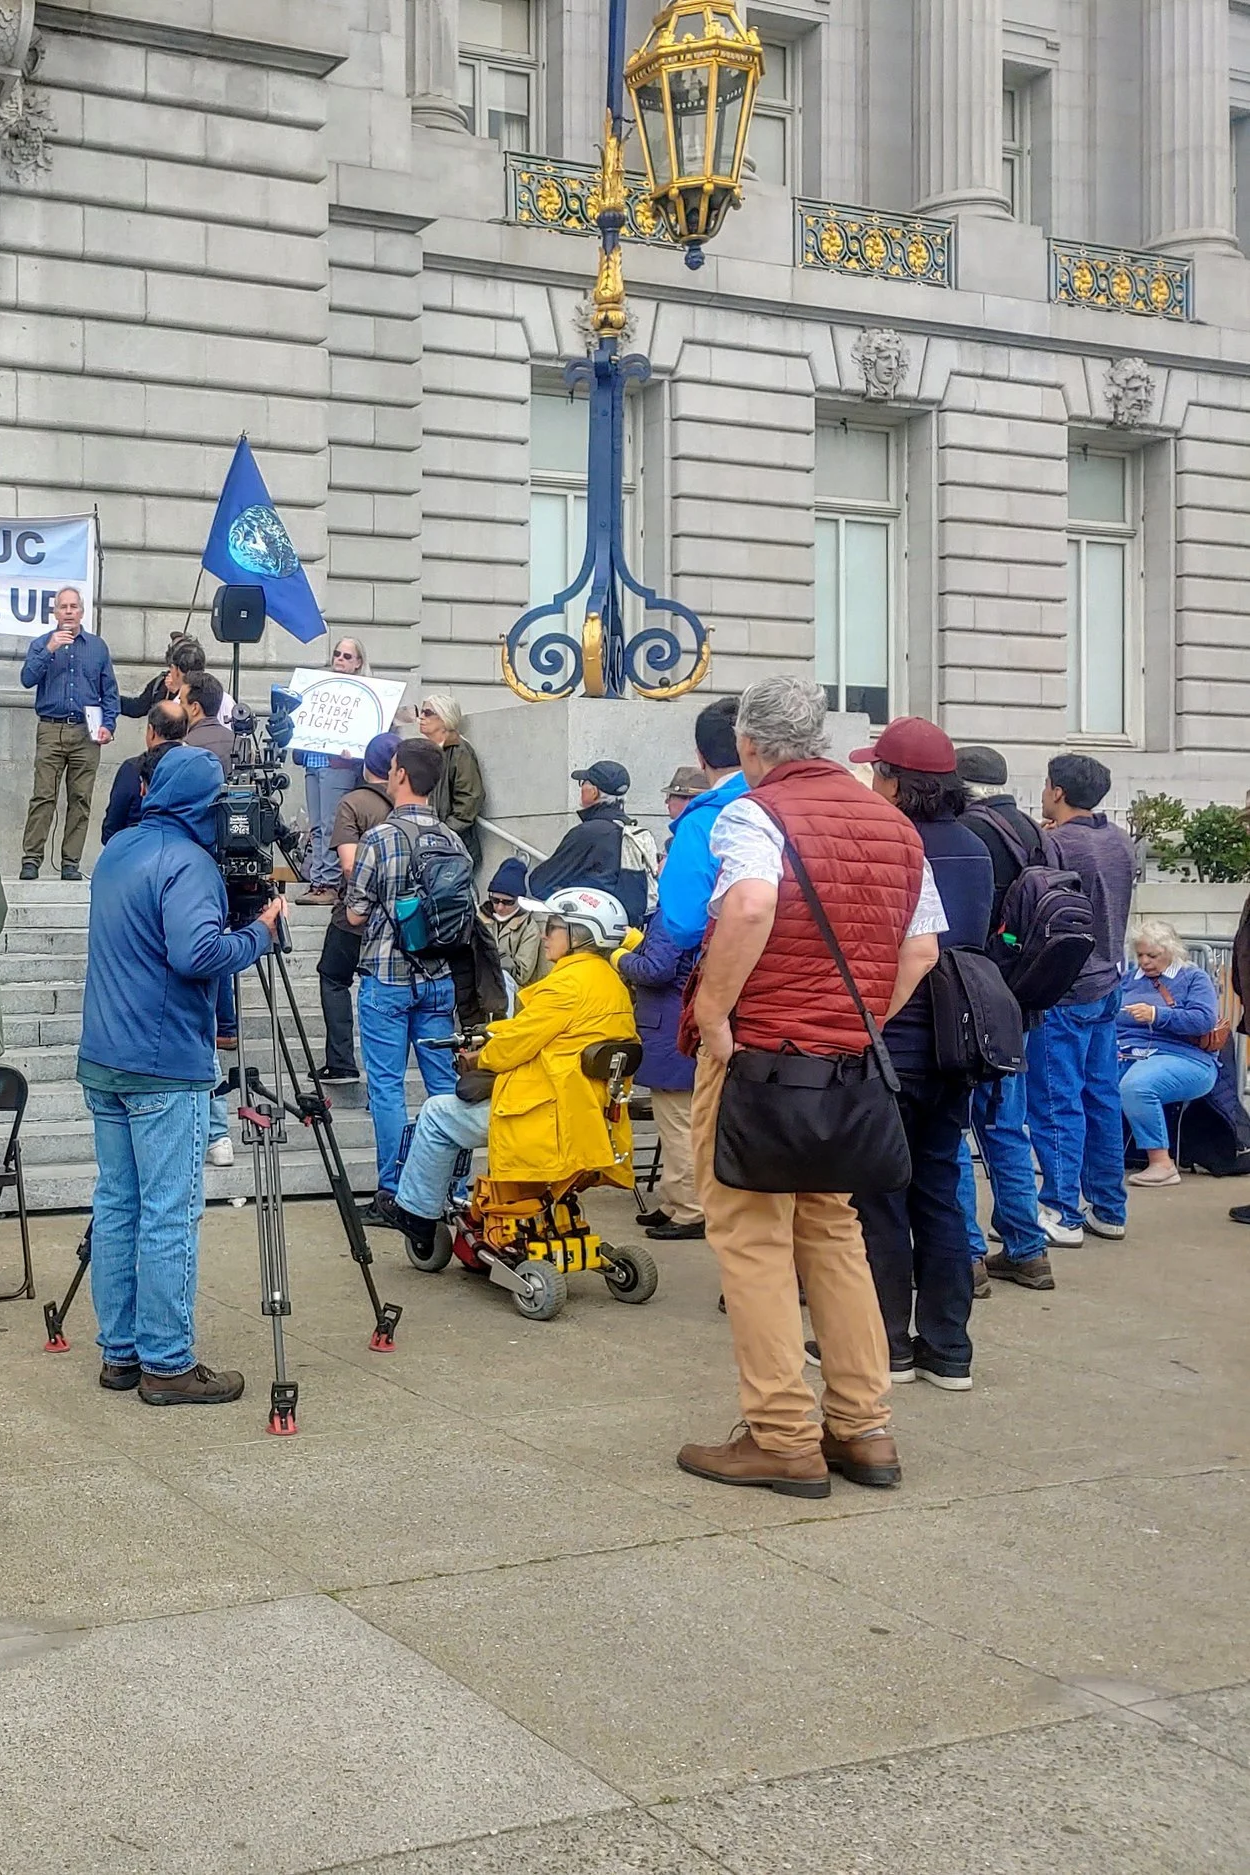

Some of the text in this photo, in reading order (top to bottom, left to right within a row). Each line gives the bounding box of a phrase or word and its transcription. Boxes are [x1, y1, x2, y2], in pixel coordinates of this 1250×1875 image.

[311, 691, 361, 708] HONOR
[311, 702, 354, 719] TRIBAL
[297, 711, 349, 733] RIGHTS
